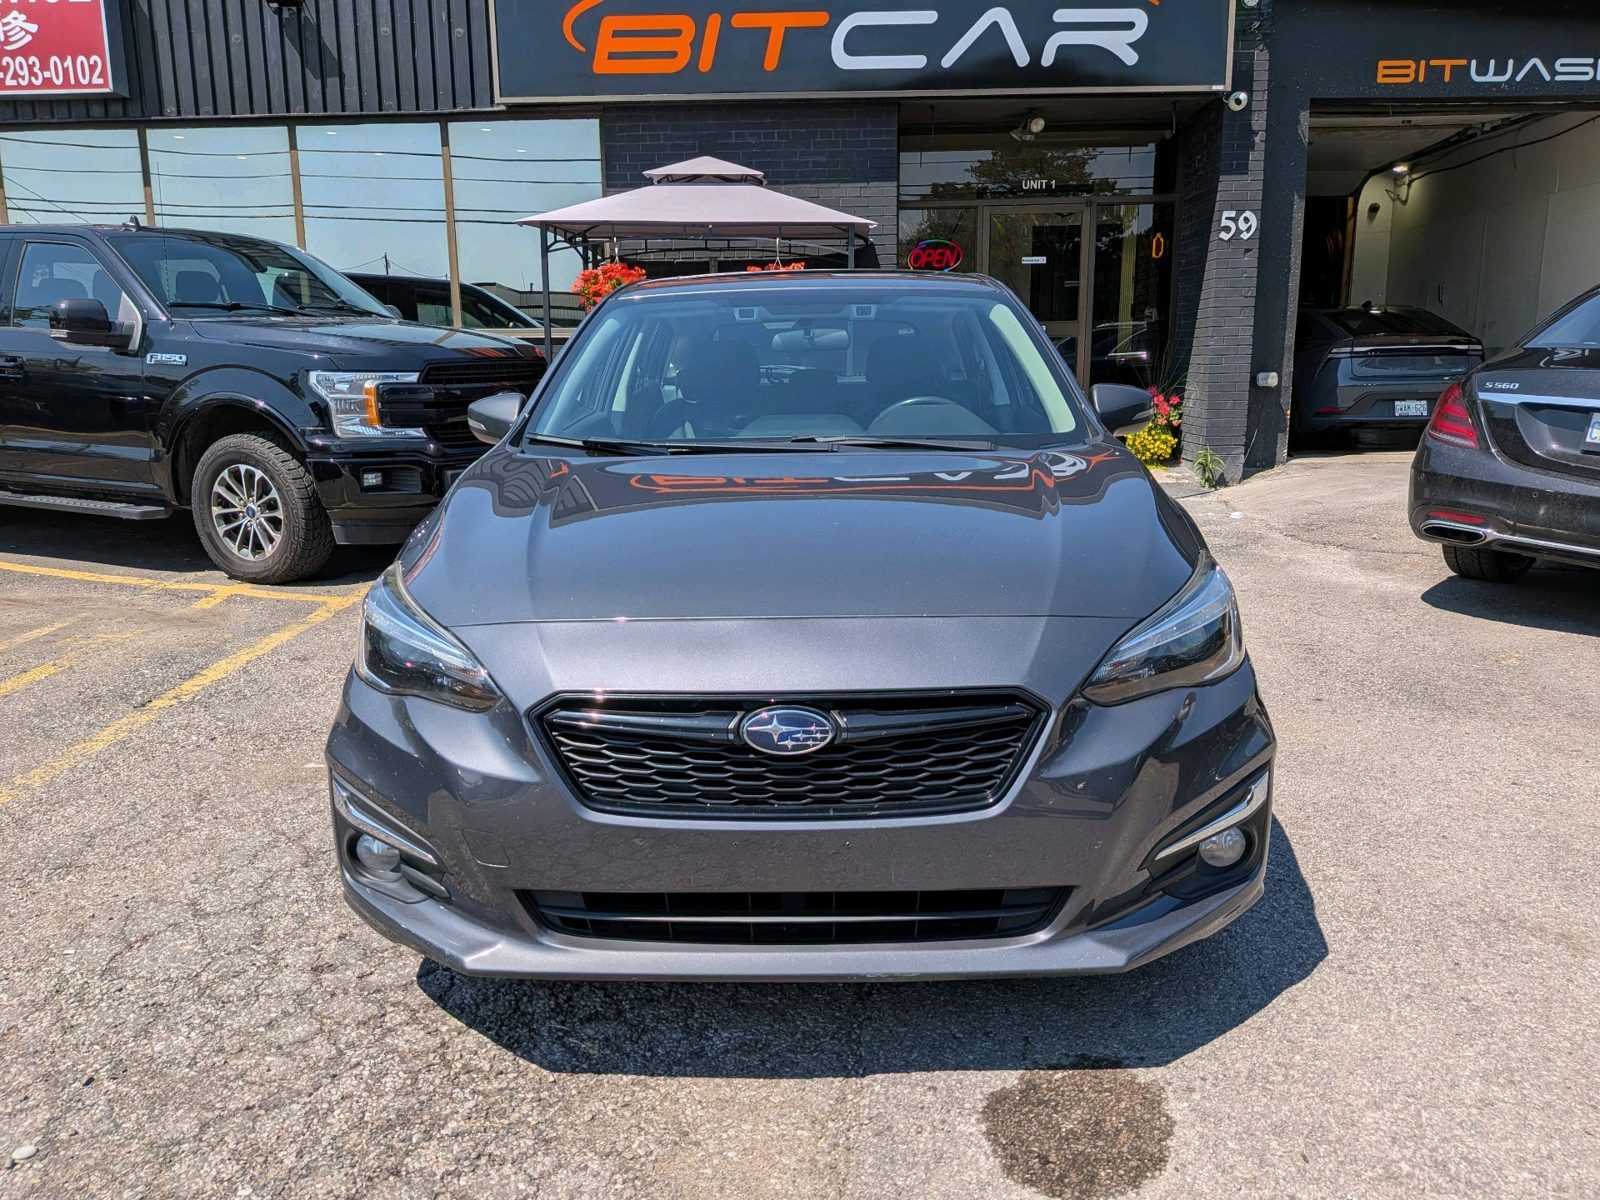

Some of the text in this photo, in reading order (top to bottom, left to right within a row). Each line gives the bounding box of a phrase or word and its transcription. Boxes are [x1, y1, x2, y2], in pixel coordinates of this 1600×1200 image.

[593, 6, 1149, 75] BITCAR
[1376, 57, 1600, 84] BITWAS
[1022, 179, 1056, 190] UNIT 1
[1218, 210, 1258, 241] 59
[910, 248, 958, 269] OPEN
[1484, 381, 1520, 390] S 560
